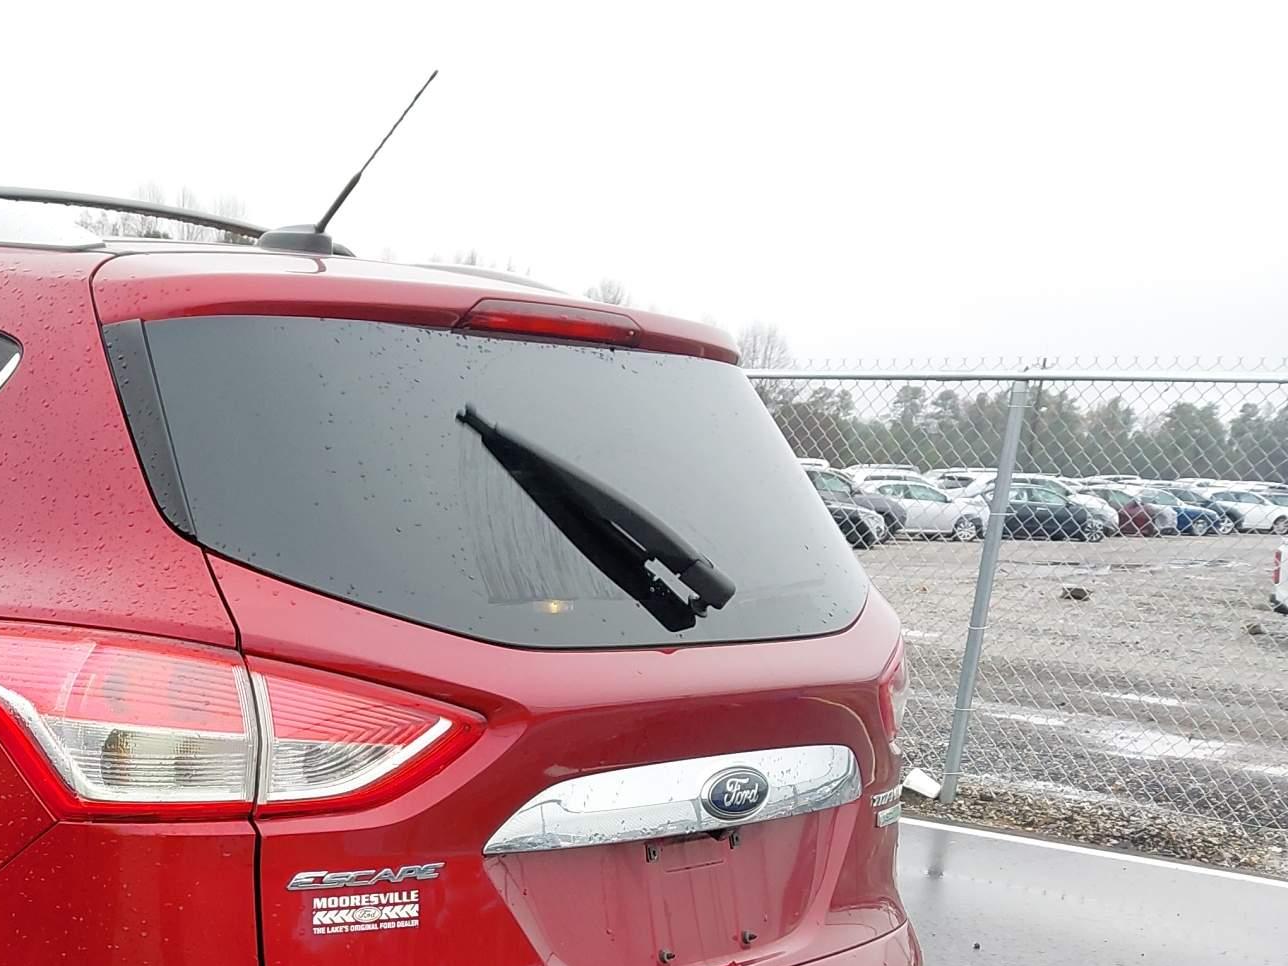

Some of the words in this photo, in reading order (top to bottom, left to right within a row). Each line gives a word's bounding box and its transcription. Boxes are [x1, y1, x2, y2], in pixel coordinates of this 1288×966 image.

[723, 777, 760, 807] Ford
[286, 861, 446, 891] ESCAPE
[312, 889, 420, 909] MOORESVILLE
[312, 926, 326, 935] THE
[326, 925, 349, 934] LAKE'S
[349, 923, 379, 932] ORIGINAL
[379, 922, 396, 930] FORD
[396, 920, 419, 929] DEALER
